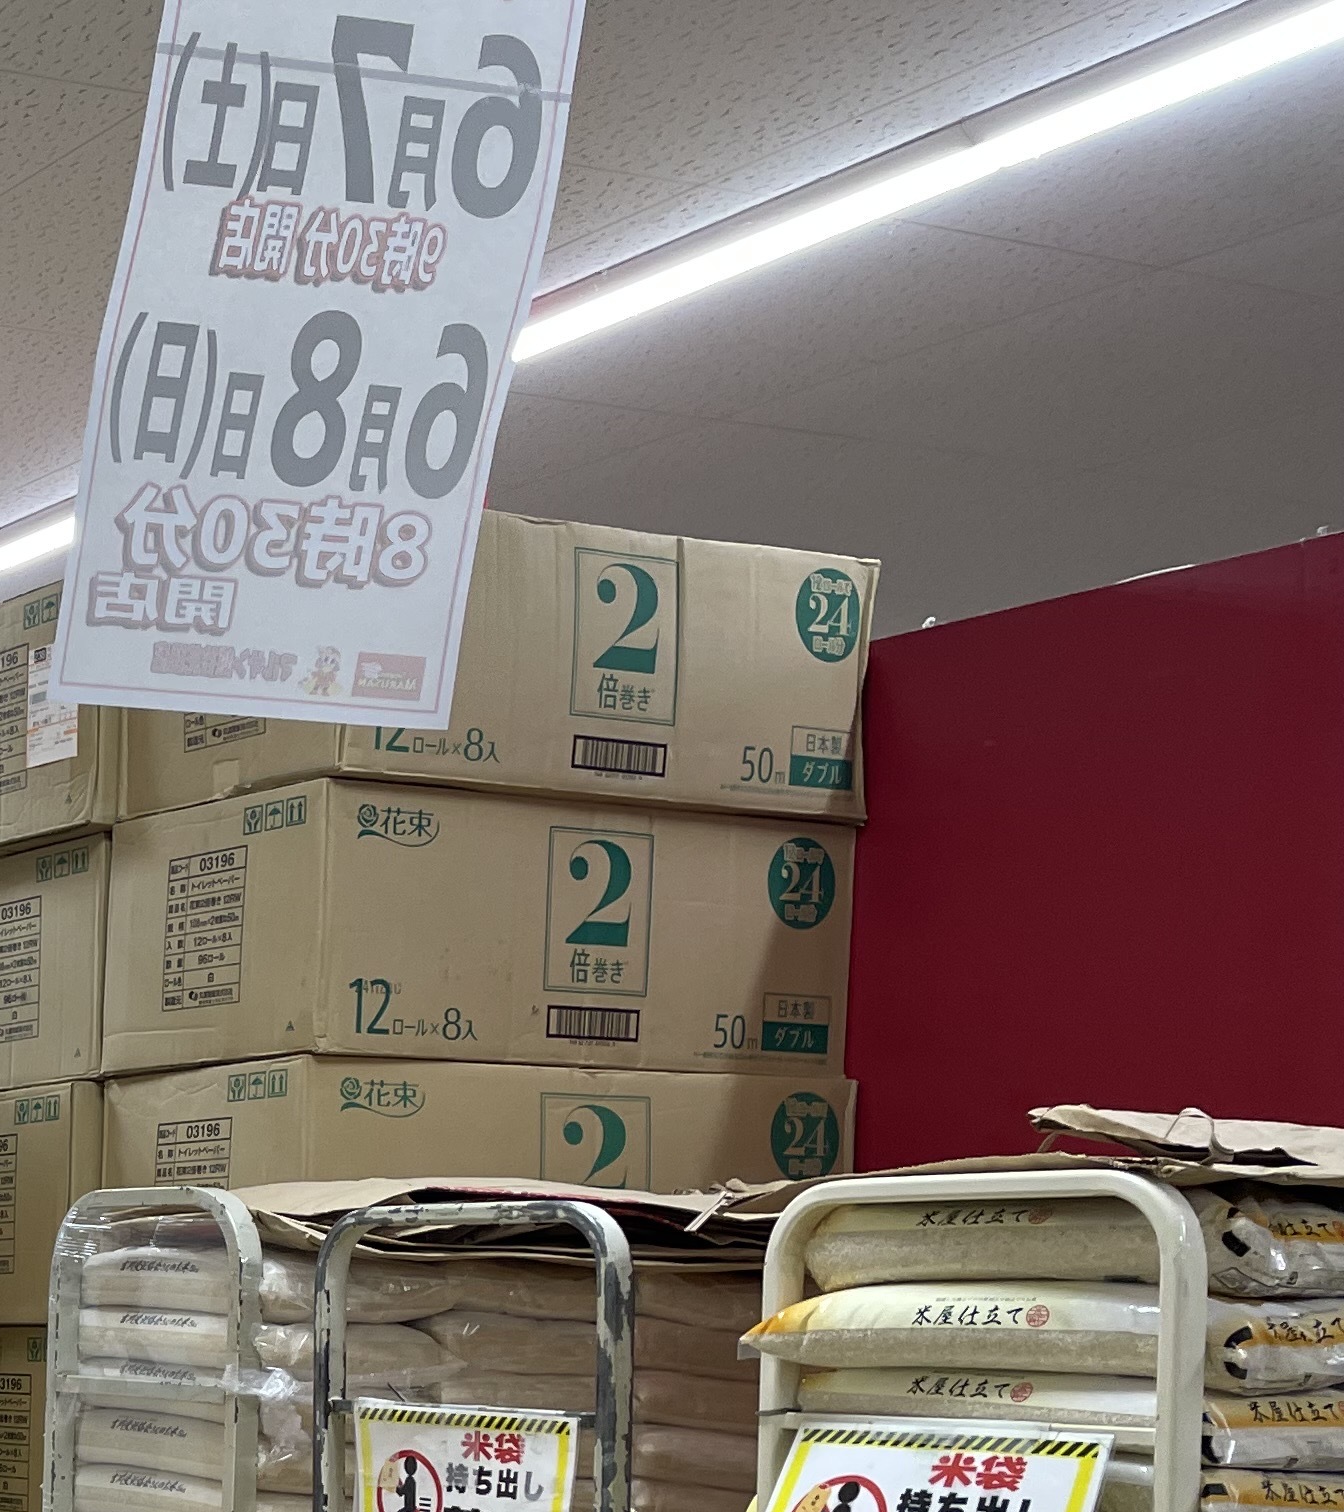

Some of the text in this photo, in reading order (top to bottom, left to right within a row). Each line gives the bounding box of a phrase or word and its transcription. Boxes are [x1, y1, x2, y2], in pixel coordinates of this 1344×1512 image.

[594, 562, 661, 675] 2
[807, 593, 852, 637] 24
[596, 673, 655, 711] 倍巻き
[805, 733, 843, 755] 日本製
[740, 745, 787, 785] 50m
[802, 761, 843, 786] ダブル
[380, 806, 434, 842] 花束
[200, 852, 235, 872] 03196
[564, 840, 633, 947] 2
[779, 862, 825, 904] 24
[1, 902, 32, 921] 03196
[569, 946, 626, 985] 倍巻き
[349, 977, 479, 1041] 12ロール×8入
[777, 999, 815, 1019] 日本製
[713, 1013, 758, 1050] 50m
[774, 1027, 814, 1049] ダブル
[363, 1079, 420, 1110] 花束
[186, 1121, 222, 1140] 03196
[562, 1103, 626, 1187] 2
[784, 1117, 830, 1157] 24
[911, 1303, 1027, 1328] 米屋仕立て
[905, 1375, 1013, 1400] 米屋仕立て
[1247, 1400, 1339, 1424] 米屋仕立て
[461, 1430, 526, 1465] 米袋
[444, 1462, 544, 1500] 持ち出し
[928, 1453, 1029, 1494] 米袋
